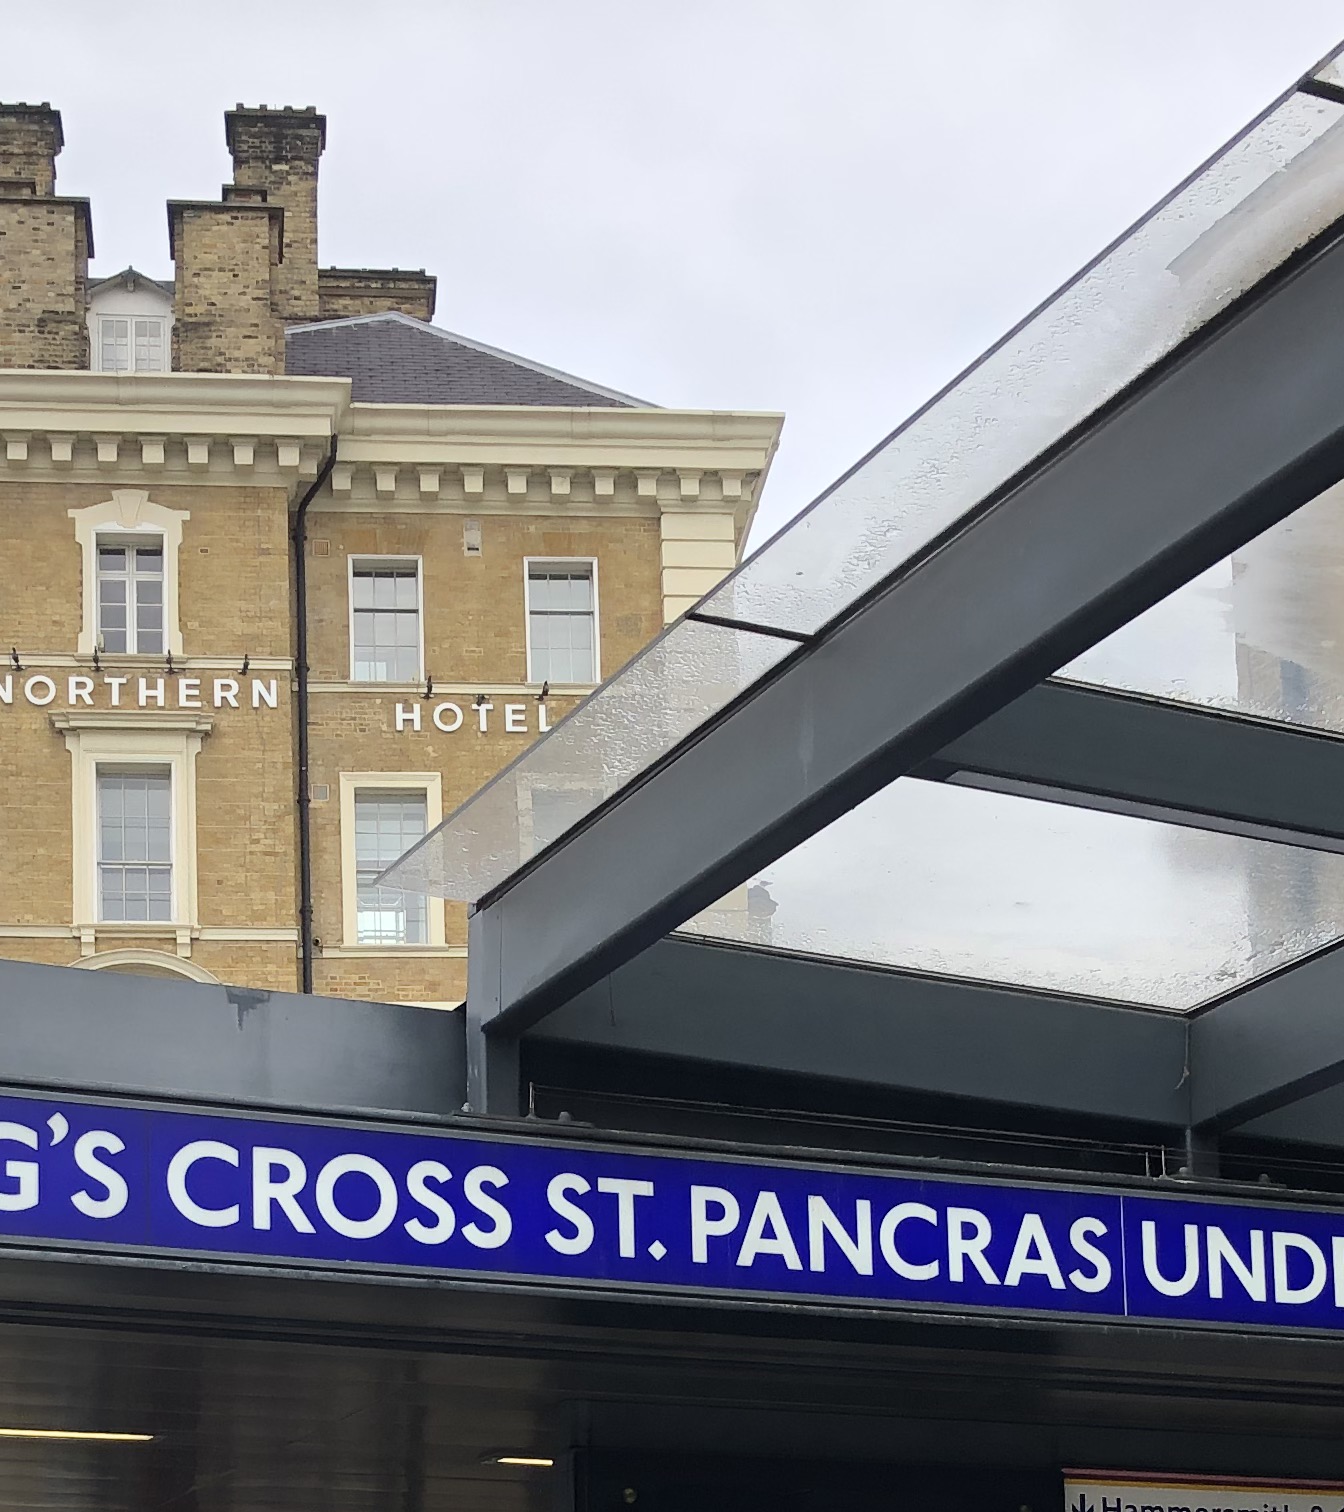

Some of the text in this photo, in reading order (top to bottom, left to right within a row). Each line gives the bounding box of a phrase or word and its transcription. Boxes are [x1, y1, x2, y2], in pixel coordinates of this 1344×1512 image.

[394, 701, 553, 733] HOTEL
[165, 1138, 514, 1250] CROSS
[543, 1171, 668, 1262] ST.
[689, 1184, 1113, 1294] PANCRAS
